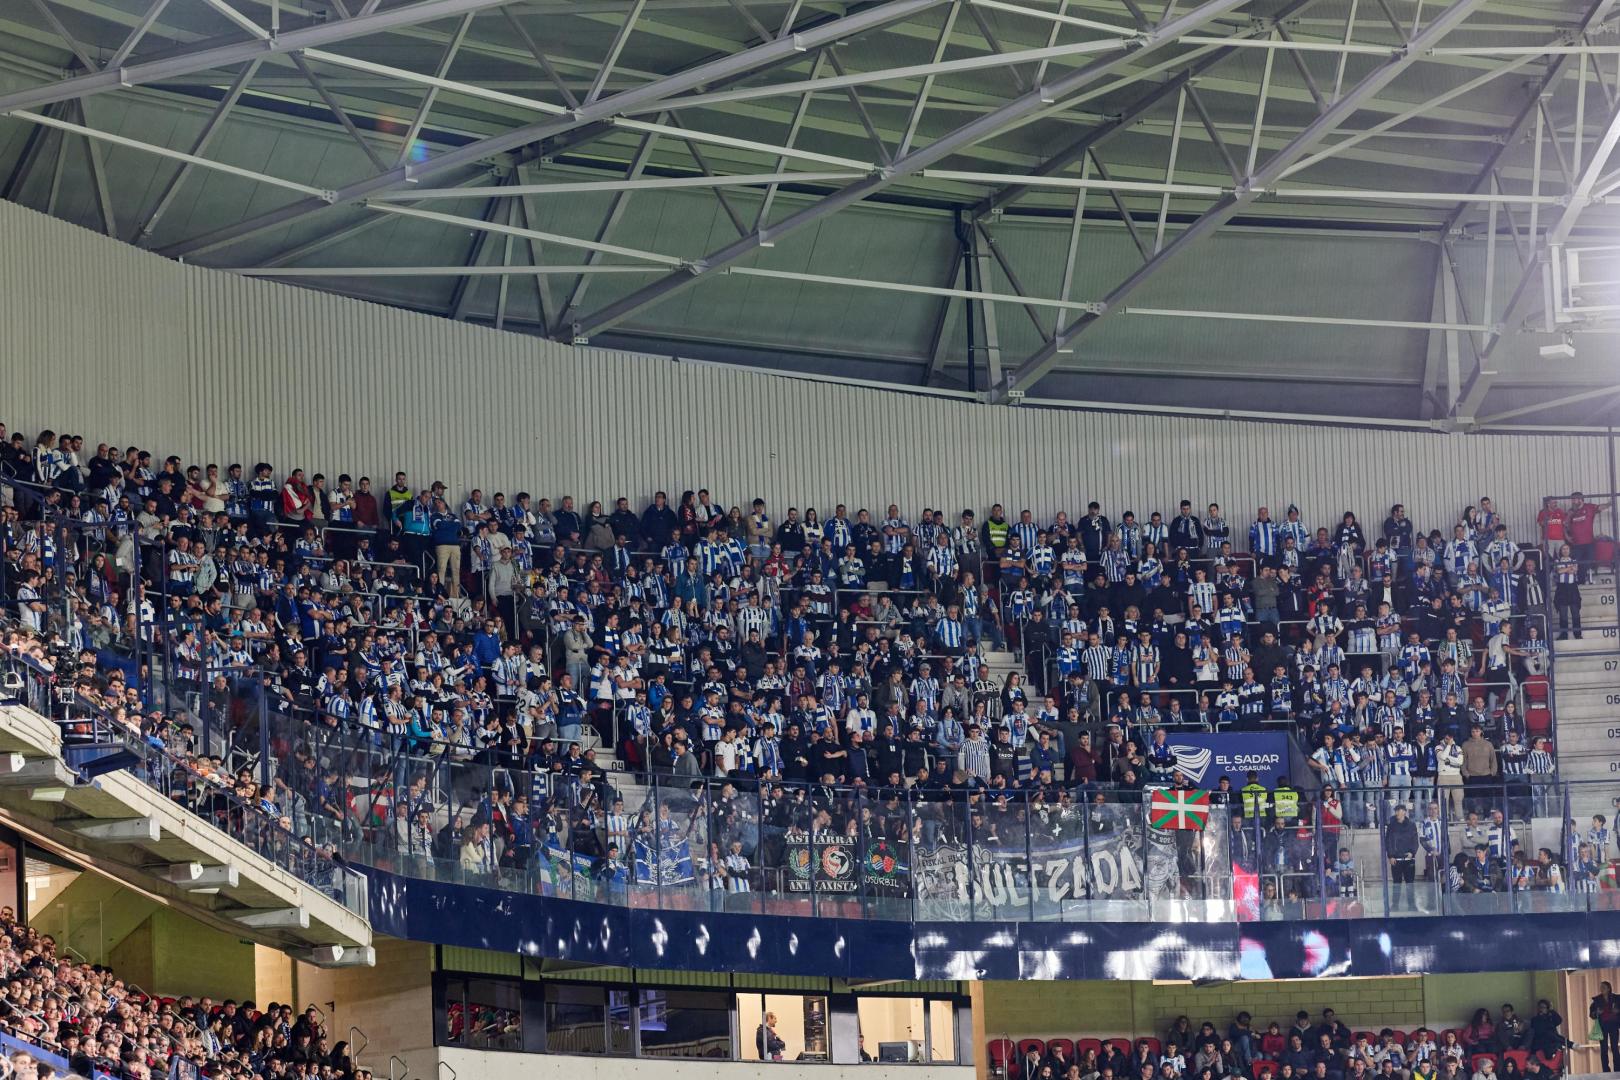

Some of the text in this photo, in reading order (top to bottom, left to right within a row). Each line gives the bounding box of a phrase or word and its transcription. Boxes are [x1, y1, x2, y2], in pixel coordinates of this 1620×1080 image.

[1600, 595, 1615, 605] 09
[1602, 629, 1617, 638] 08
[1604, 660, 1618, 670] 07
[1606, 694, 1620, 705] 06
[1215, 754, 1279, 764] EL SADAR
[611, 761, 624, 771] 04
[864, 875, 899, 888] USURBIL
[954, 846, 1142, 907] BULTZADA
